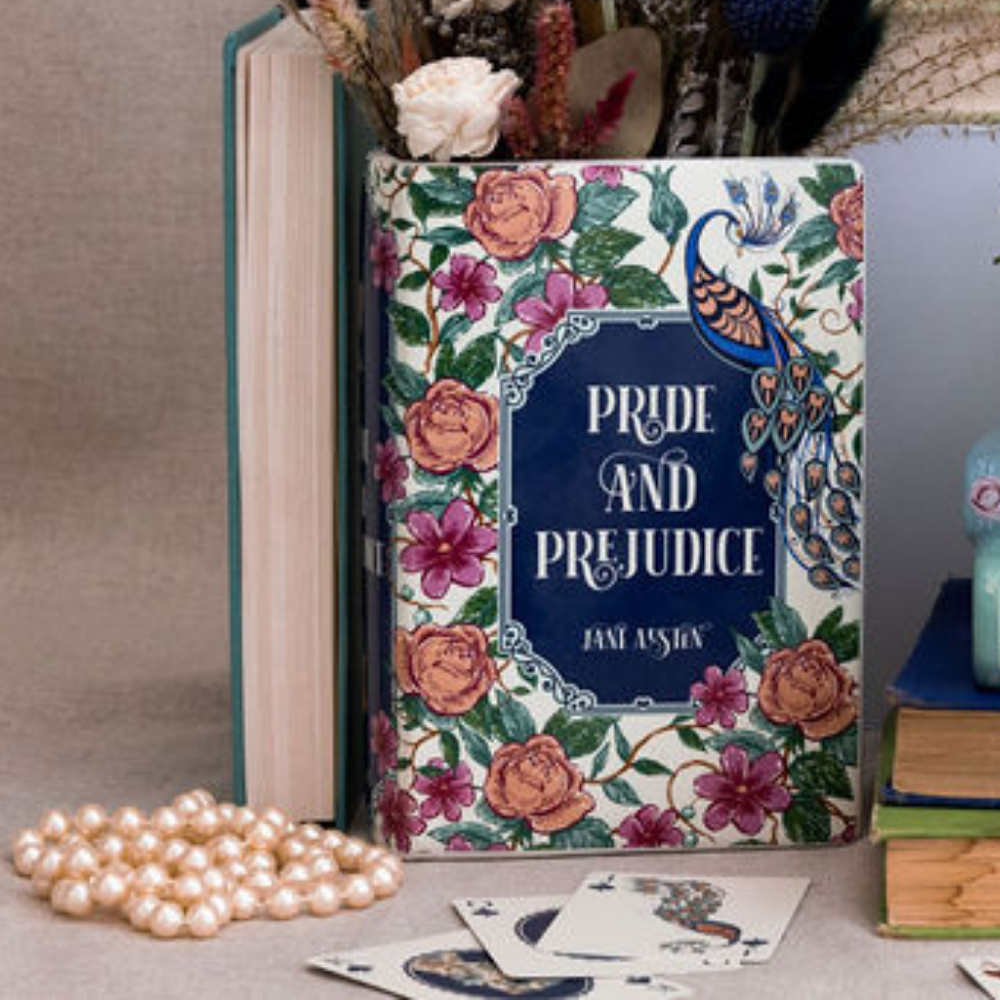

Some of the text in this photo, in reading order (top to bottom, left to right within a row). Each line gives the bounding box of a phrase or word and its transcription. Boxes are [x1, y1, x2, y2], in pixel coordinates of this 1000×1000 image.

[587, 384, 716, 445] PRIDE
[600, 447, 697, 512] AND
[534, 527, 764, 591] PREJUDICE
